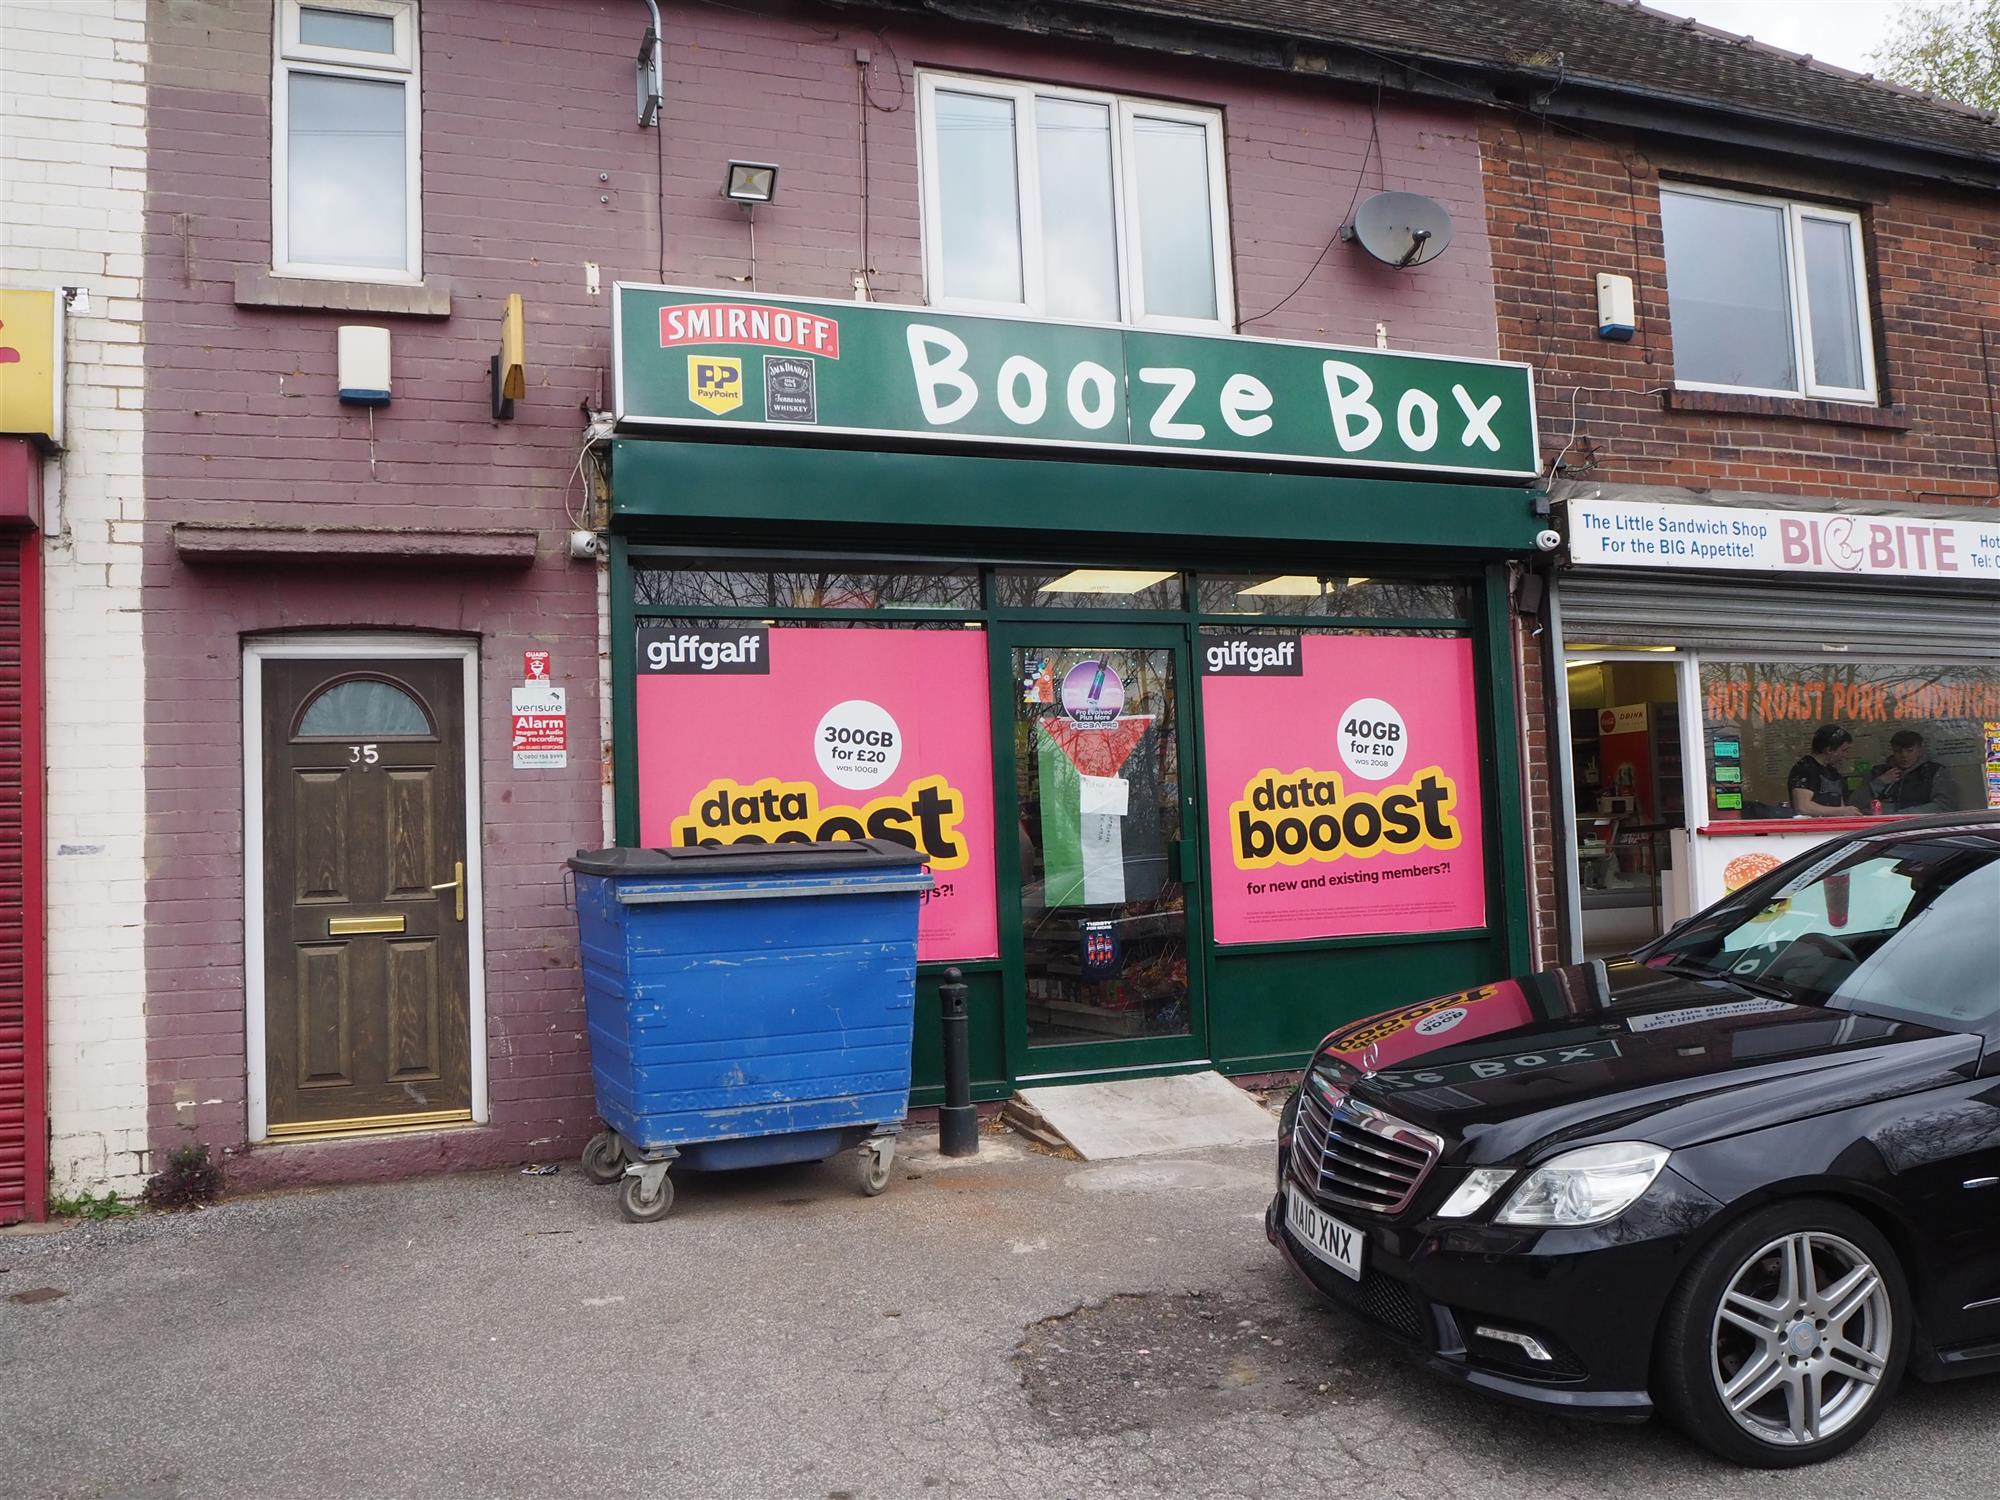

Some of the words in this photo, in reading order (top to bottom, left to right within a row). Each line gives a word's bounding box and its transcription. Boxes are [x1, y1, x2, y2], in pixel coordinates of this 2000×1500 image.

[667, 308, 830, 350] SMIRNOFF
[697, 364, 738, 389] PP
[906, 323, 1274, 441] Booze
[1322, 359, 1503, 453] Box
[697, 389, 738, 400] PayPoint
[773, 404, 808, 413] WHISKEY
[1582, 513, 1611, 530] The
[1616, 514, 1655, 532] Little
[1658, 517, 1728, 536] Sandwich
[1732, 520, 1768, 540] Shop
[1601, 537, 1626, 554] For
[1630, 538, 1655, 554] the
[1659, 539, 1686, 555] BIG
[1690, 540, 1755, 559] Appetite!
[1869, 524, 1959, 571] BITE
[1980, 534, 2000, 549] Hot
[1970, 553, 1992, 568] Tel:
[646, 635, 760, 670] giffgaff
[1206, 640, 1295, 672] giffgaff
[515, 704, 563, 712] verisure
[1708, 681, 1750, 721] HOT
[1758, 681, 1825, 723] ROAST
[1832, 681, 1888, 722] PORK
[516, 716, 564, 729] Alarm
[1344, 718, 1401, 742] 40GB
[528, 736, 564, 744] recording
[824, 726, 893, 748] 300GB
[1350, 740, 1370, 754] for
[1372, 743, 1394, 757] £10
[348, 744, 379, 764] 35
[831, 746, 854, 760] for
[856, 750, 886, 763] £20
[854, 765, 879, 774] 100GB
[1252, 778, 1336, 812] data
[701, 789, 809, 827] data
[1238, 775, 1454, 860] booost
[1246, 882, 1266, 895] for
[1269, 879, 1298, 893] new
[1300, 875, 1326, 889] and
[1329, 870, 1379, 885] existing
[1381, 861, 1451, 881] members?!
[1292, 1192, 1316, 1240] NA10
[1319, 1215, 1352, 1264] XNX
